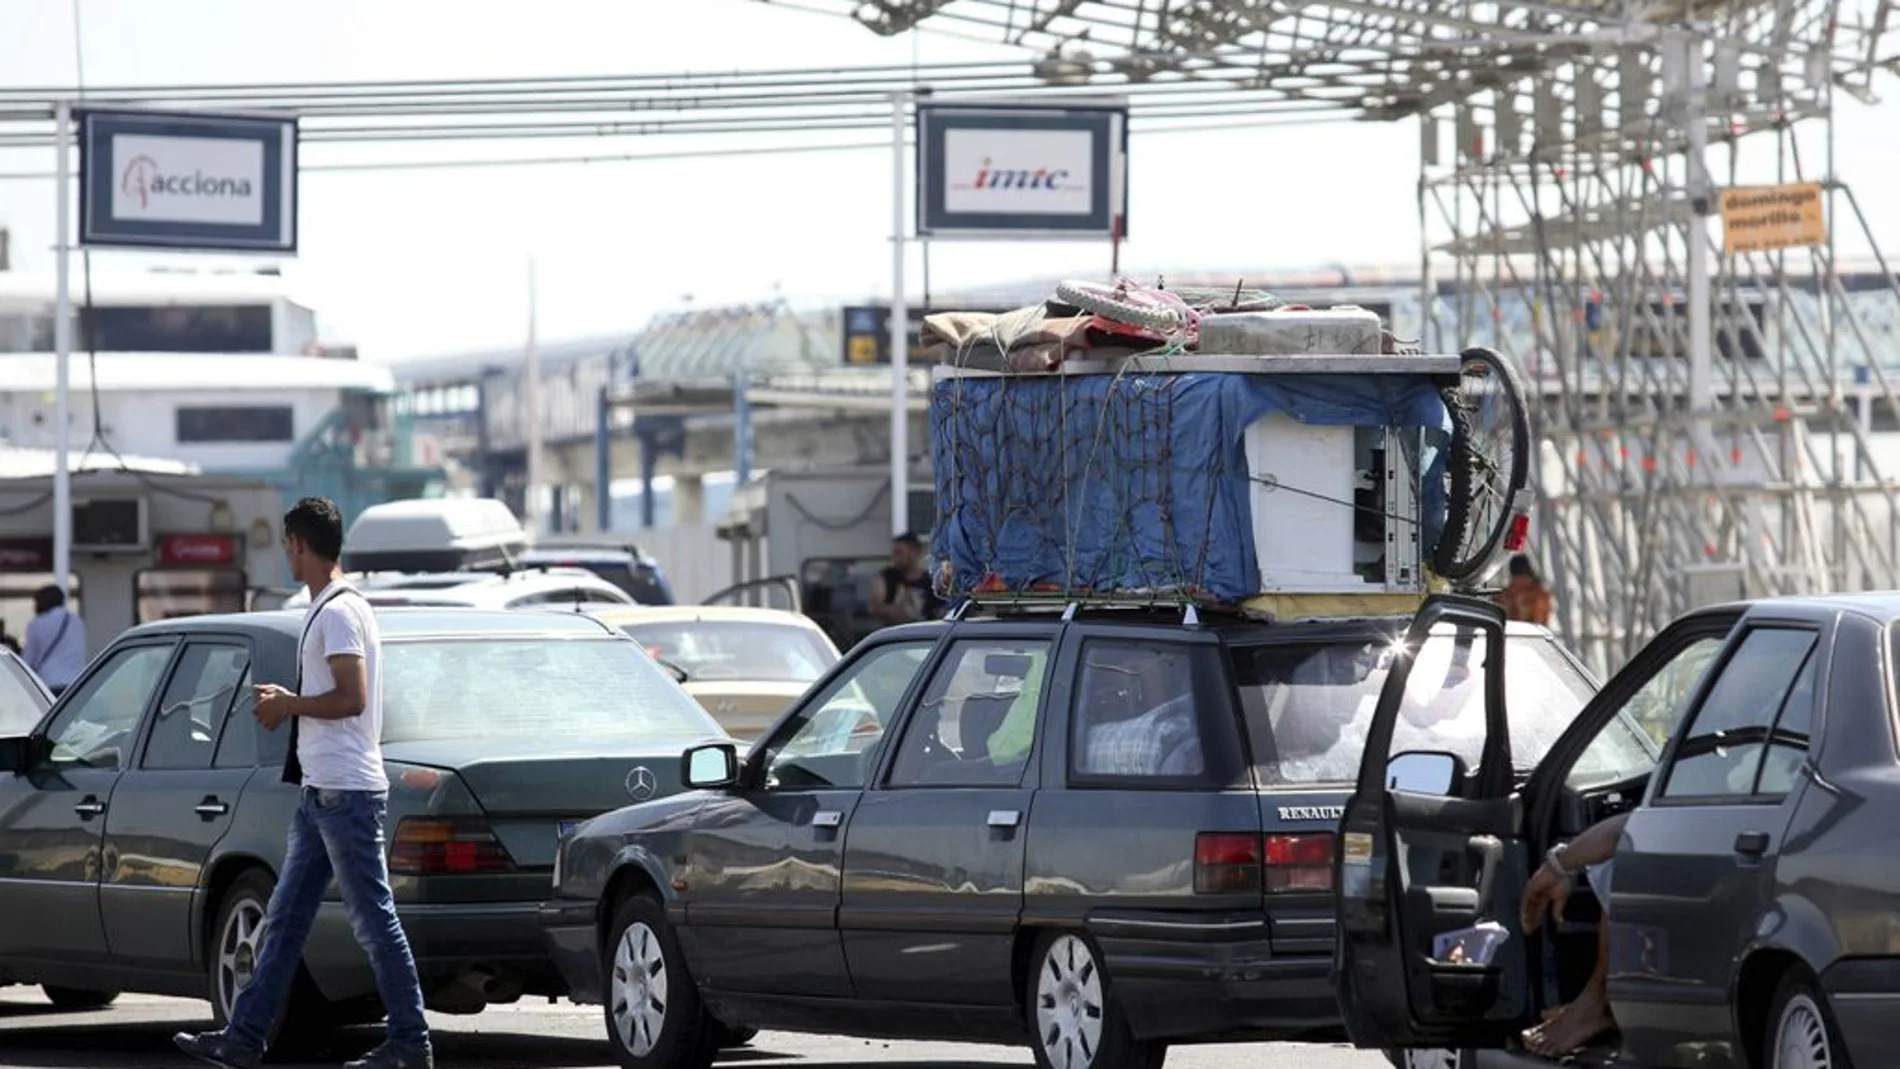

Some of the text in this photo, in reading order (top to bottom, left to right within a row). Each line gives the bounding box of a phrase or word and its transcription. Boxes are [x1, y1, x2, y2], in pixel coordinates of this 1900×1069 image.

[150, 169, 252, 197] acciona
[975, 157, 1069, 190] imtc
[1277, 804, 1346, 820] RENAULT
